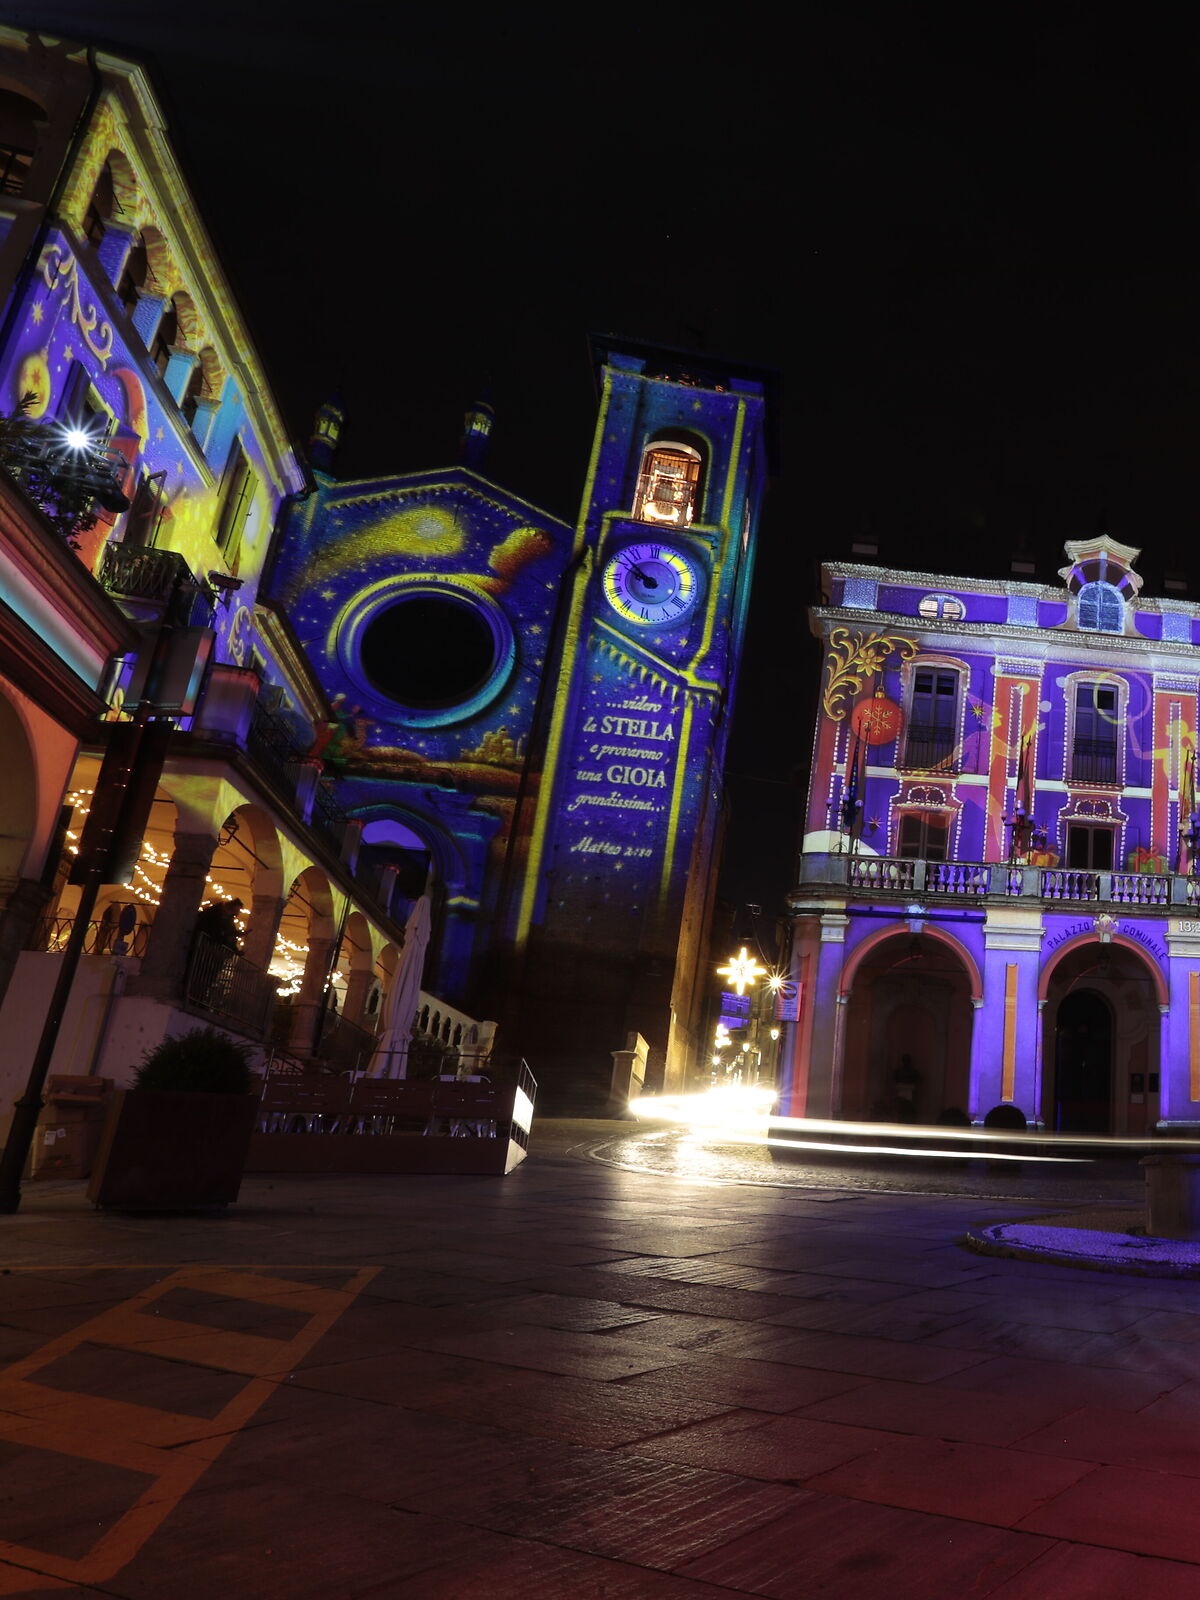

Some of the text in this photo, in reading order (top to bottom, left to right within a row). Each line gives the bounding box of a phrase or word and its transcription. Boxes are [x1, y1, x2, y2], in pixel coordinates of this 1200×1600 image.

[606, 696, 662, 712] ...videro
[582, 715, 675, 741] la STELLA
[589, 743, 663, 761] e provarono
[576, 765, 667, 788] una GIOIA
[569, 837, 622, 855] Matteo
[1047, 922, 1167, 960] PALAZZO COMUNALE
